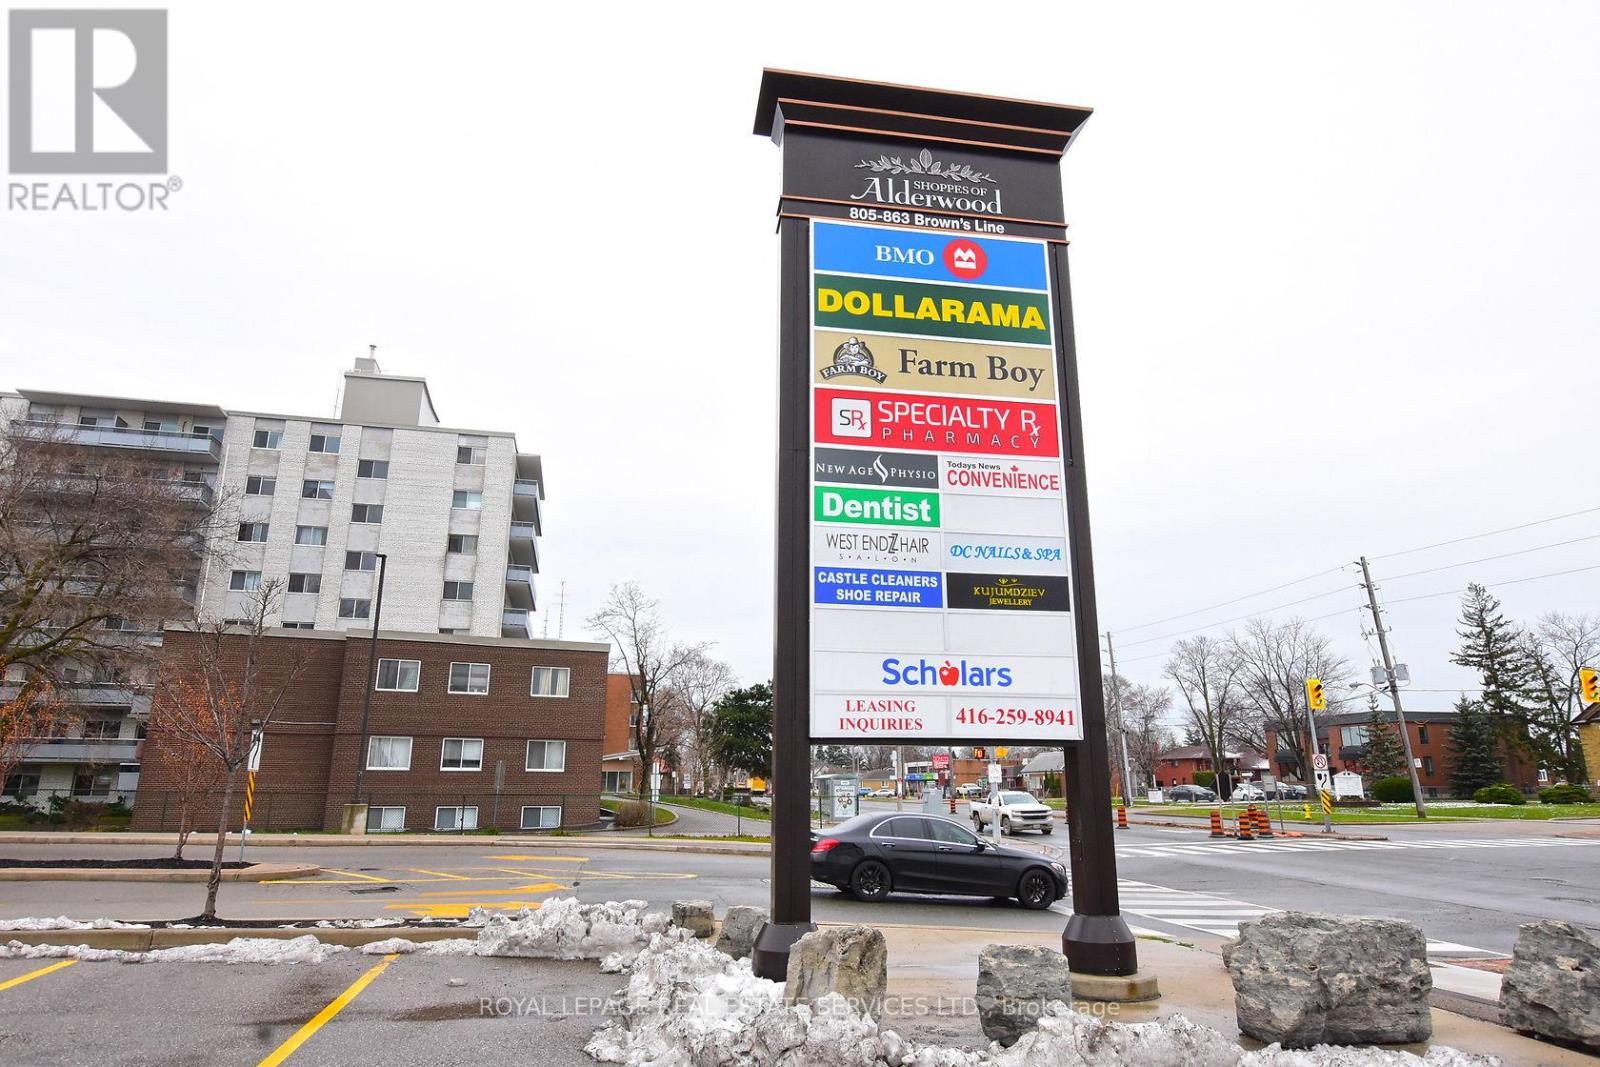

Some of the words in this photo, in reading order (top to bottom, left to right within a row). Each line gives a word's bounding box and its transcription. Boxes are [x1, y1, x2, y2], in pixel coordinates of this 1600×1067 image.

[850, 177, 1003, 215] Alderwood
[913, 180, 969, 195] SHOPPES
[970, 187, 988, 197] OF
[850, 207, 910, 224] 805-863
[914, 213, 971, 231] Brown's
[975, 220, 1005, 234] Line
[875, 244, 934, 267] BMO
[817, 287, 1047, 331] DOLLARAMA
[822, 365, 856, 378] FARM
[860, 366, 885, 381] BOY
[898, 348, 977, 379] Farm
[986, 355, 1045, 392] Boy
[878, 400, 1010, 430] SPECIALTY
[882, 427, 1040, 449] PHARMACY
[816, 463, 846, 474] NEW
[848, 465, 874, 476] AGE
[890, 467, 936, 480] PHYSIO
[947, 461, 976, 470] Todays
[947, 469, 1060, 491] CONVENIENCE
[822, 492, 931, 522] Dentist
[826, 533, 858, 550] WEST
[900, 537, 930, 554] HAIR
[950, 545, 973, 558] DC
[974, 545, 1021, 560] NAILS
[1021, 547, 1033, 560] &
[1034, 548, 1062, 561] SPA
[818, 572, 868, 586] CASTLE
[871, 573, 938, 588] CLEANERS
[836, 589, 871, 602] SHOE
[875, 590, 921, 603] REPAIR
[973, 586, 1045, 598] KUJUMDZIEV
[989, 597, 1033, 606] JEWELLERY
[845, 699, 916, 714] LEASING
[956, 707, 1075, 727] 416-259-8941
[839, 717, 923, 731] INQUIRIES
